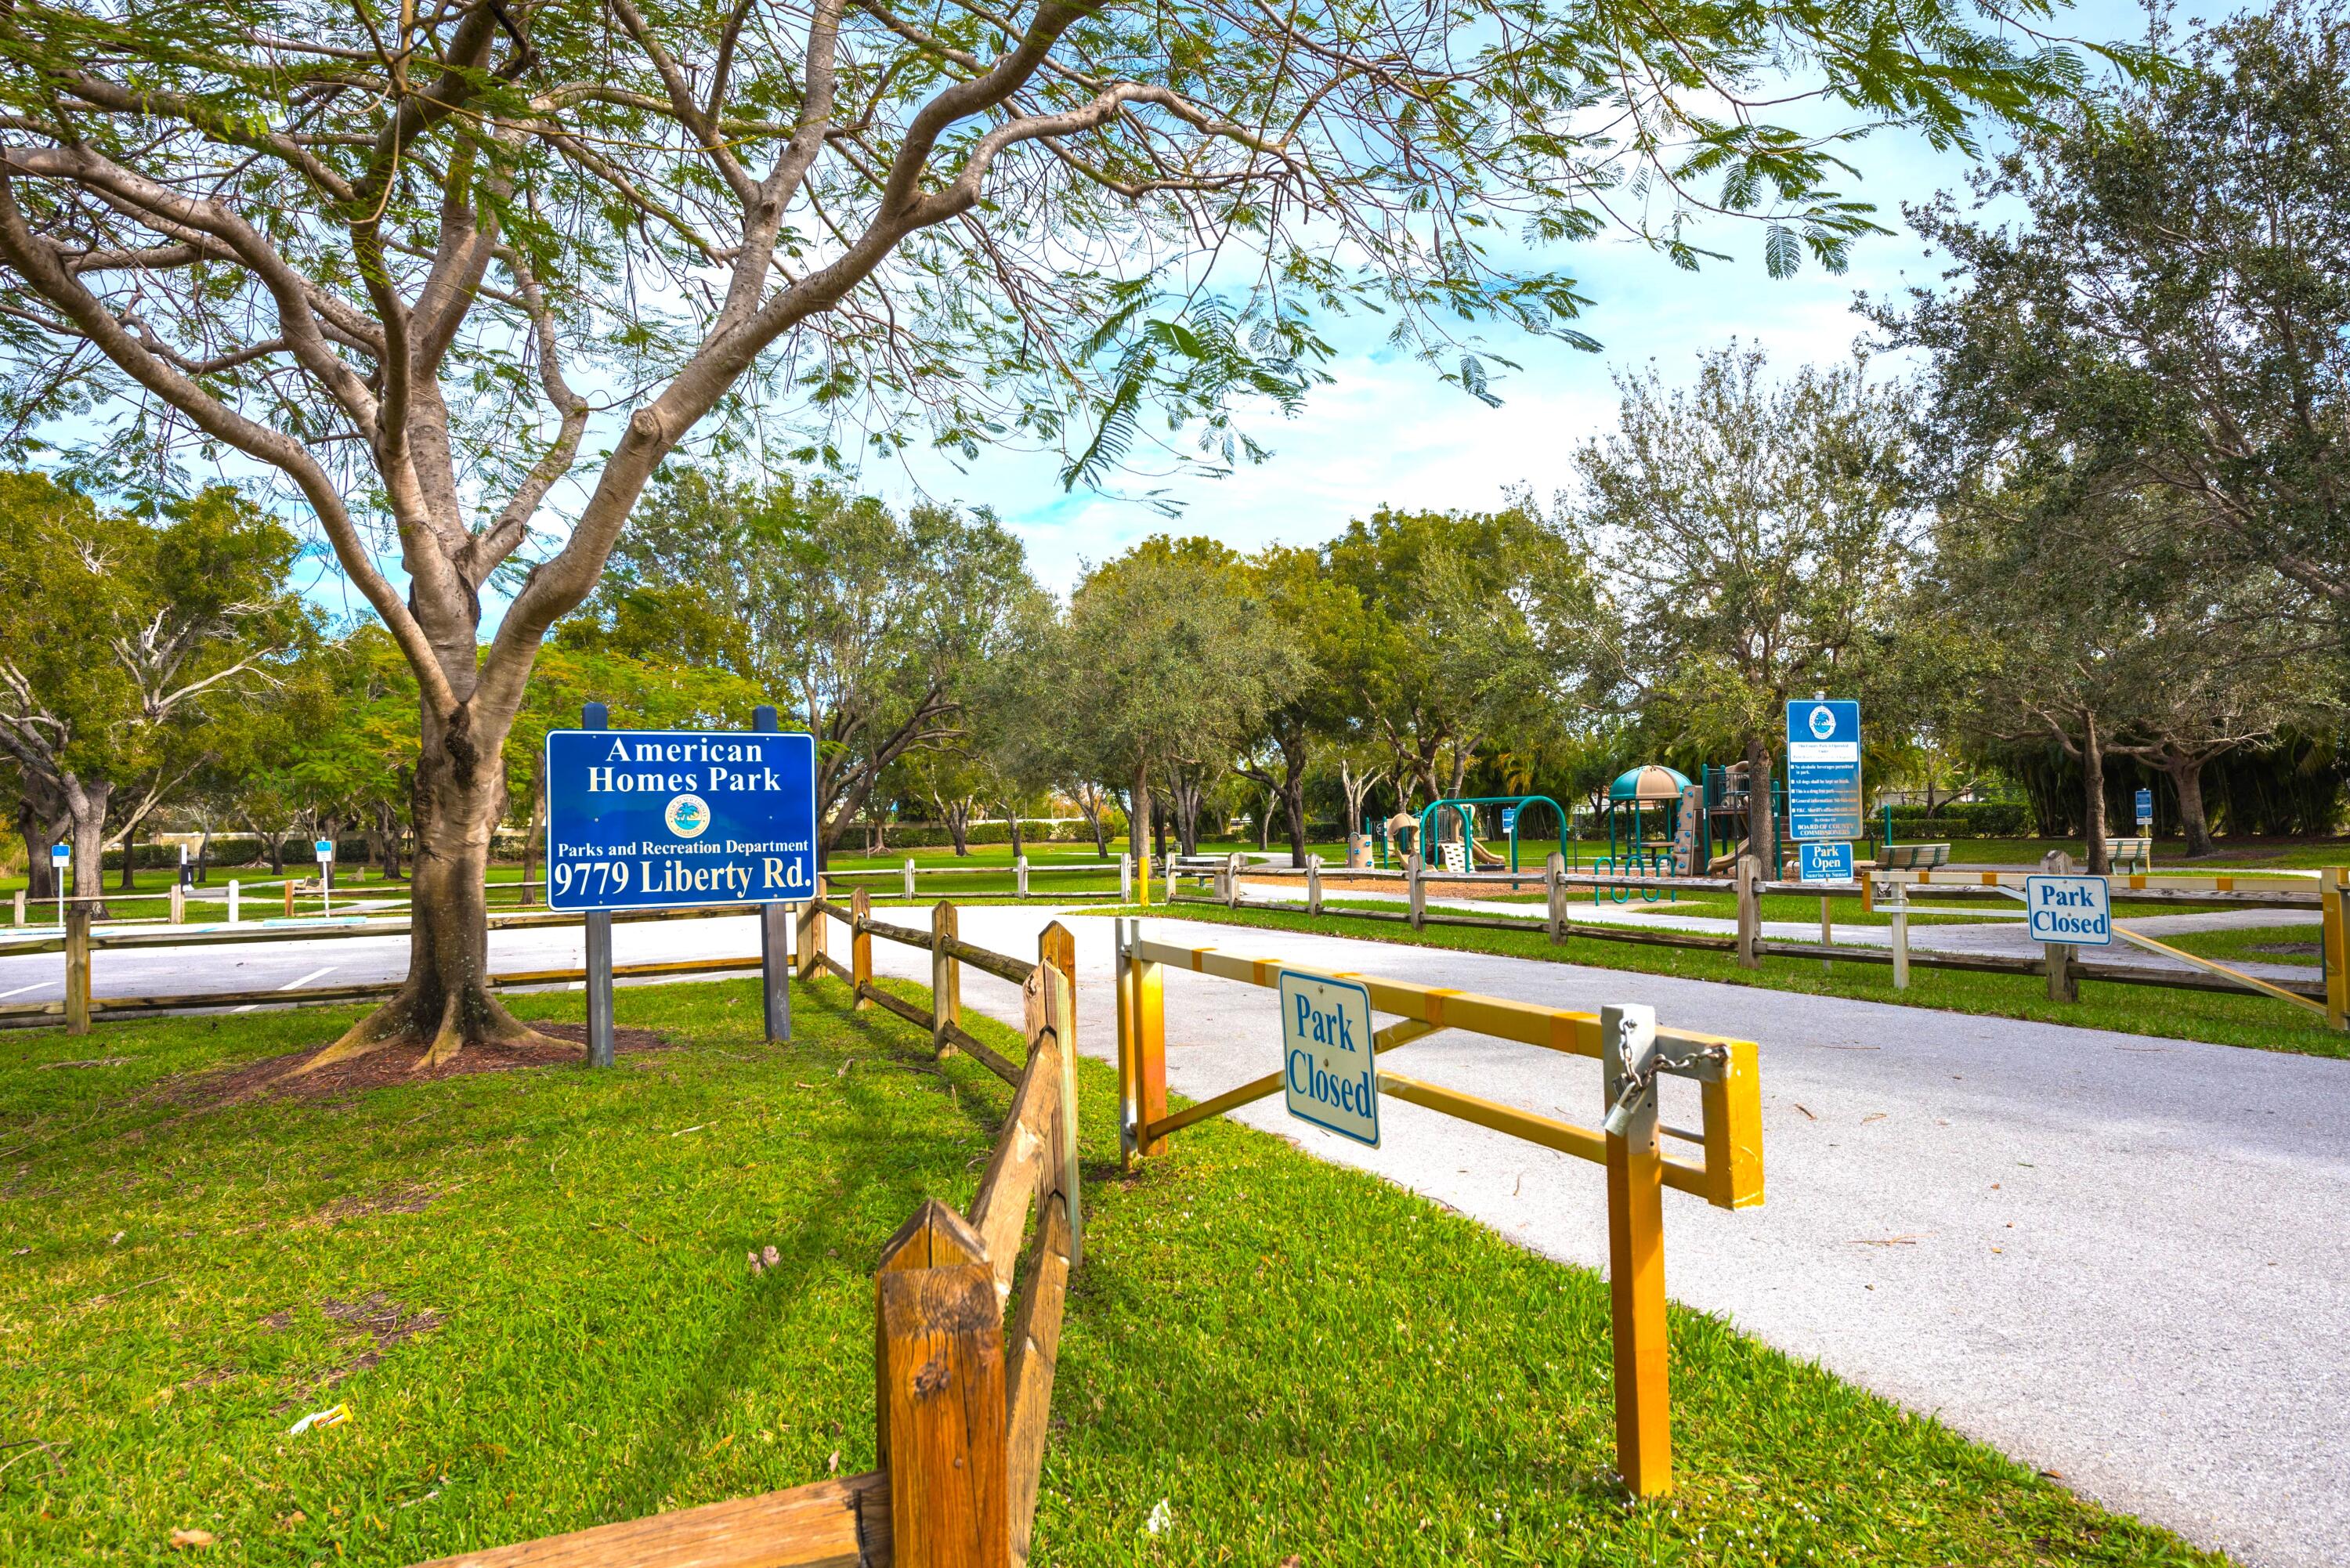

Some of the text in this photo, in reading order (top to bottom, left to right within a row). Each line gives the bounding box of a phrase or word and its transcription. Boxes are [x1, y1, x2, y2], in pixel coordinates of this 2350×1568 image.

[606, 737, 763, 763] American
[587, 767, 782, 792] Homes Park
[558, 839, 808, 857] Parks and Recreation Department
[1813, 846, 1839, 857] Park
[1812, 857, 1841, 871] Open
[555, 857, 812, 898] 9779 Liberty Rd.
[2041, 885, 2095, 907] Park
[2033, 910, 2106, 934] Closed
[1294, 993, 1356, 1053] Park
[1289, 1049, 1372, 1118] Closed
